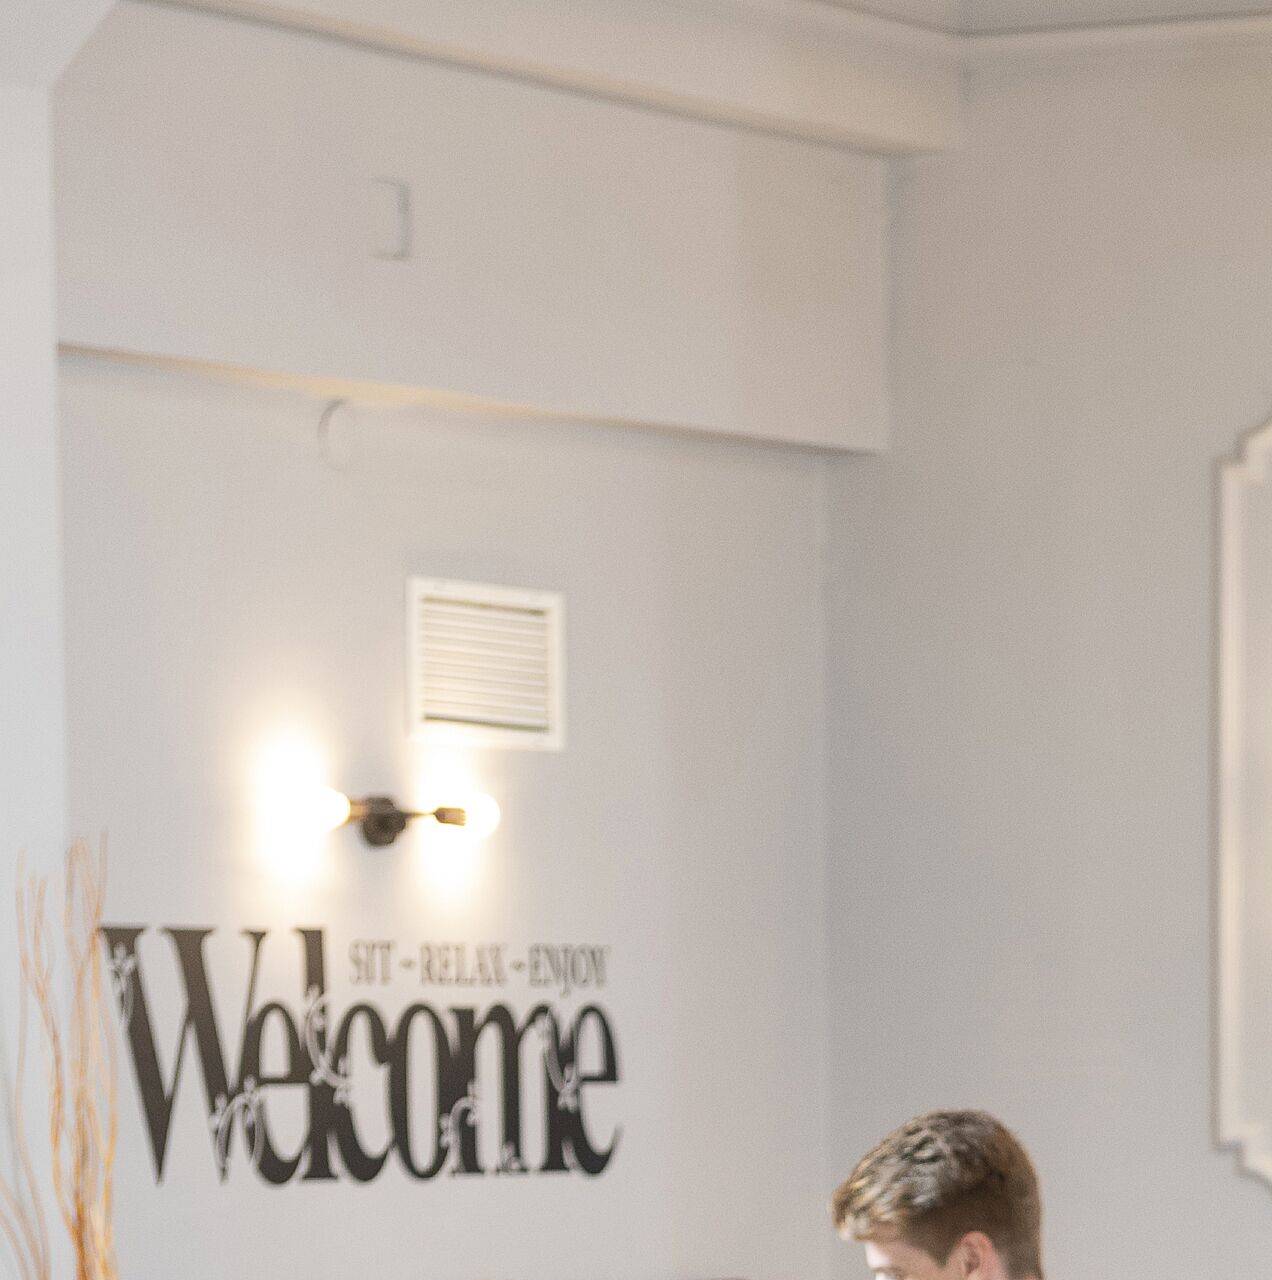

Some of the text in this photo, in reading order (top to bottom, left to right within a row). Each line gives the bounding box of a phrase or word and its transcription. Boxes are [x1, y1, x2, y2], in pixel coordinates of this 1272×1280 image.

[348, 939, 611, 998] SIT RELAX ENJOY
[98, 926, 623, 1187] Welcome
